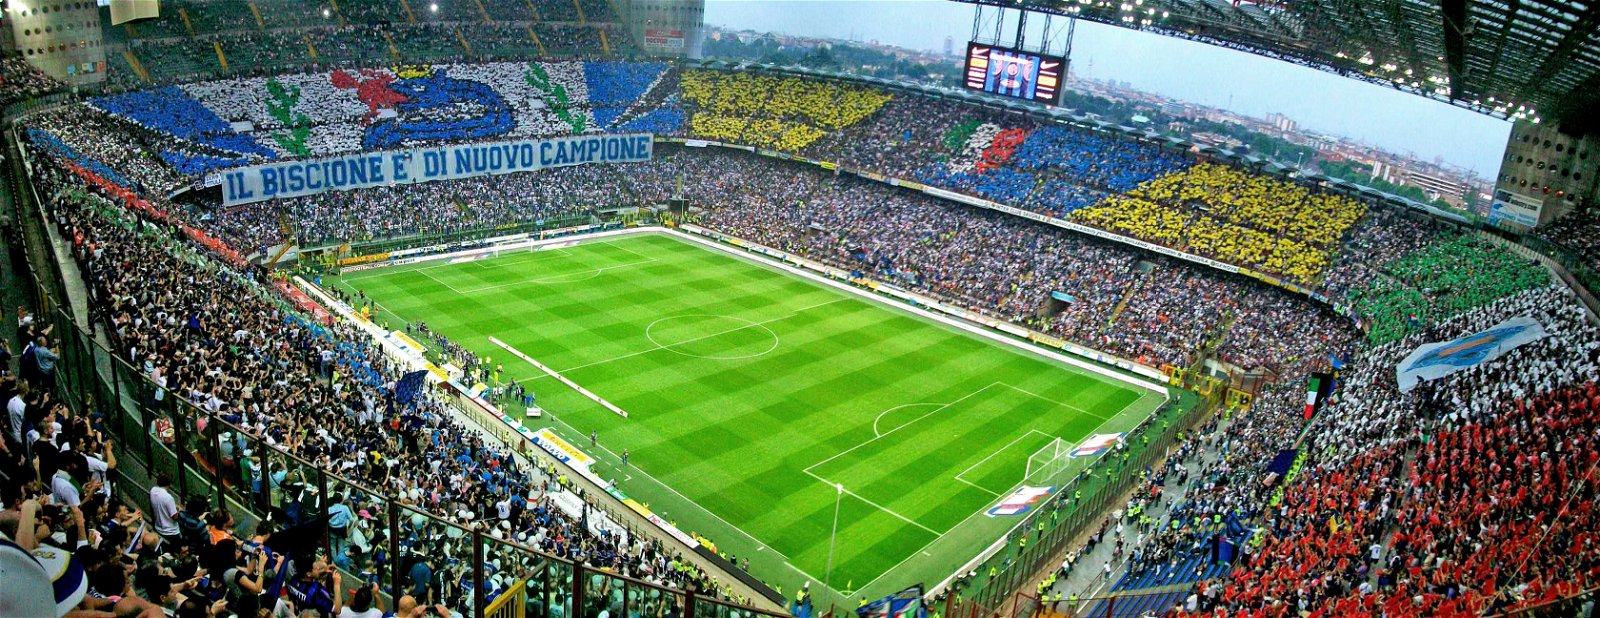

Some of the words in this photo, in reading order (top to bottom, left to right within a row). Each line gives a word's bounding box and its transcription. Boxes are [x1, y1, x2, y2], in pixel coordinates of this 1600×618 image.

[226, 171, 253, 201] IL
[259, 156, 384, 196] BISCIONE
[391, 153, 413, 181] E'
[423, 151, 448, 177] DI
[454, 143, 533, 175] NUOVO
[539, 136, 651, 167] CAMPIONE
